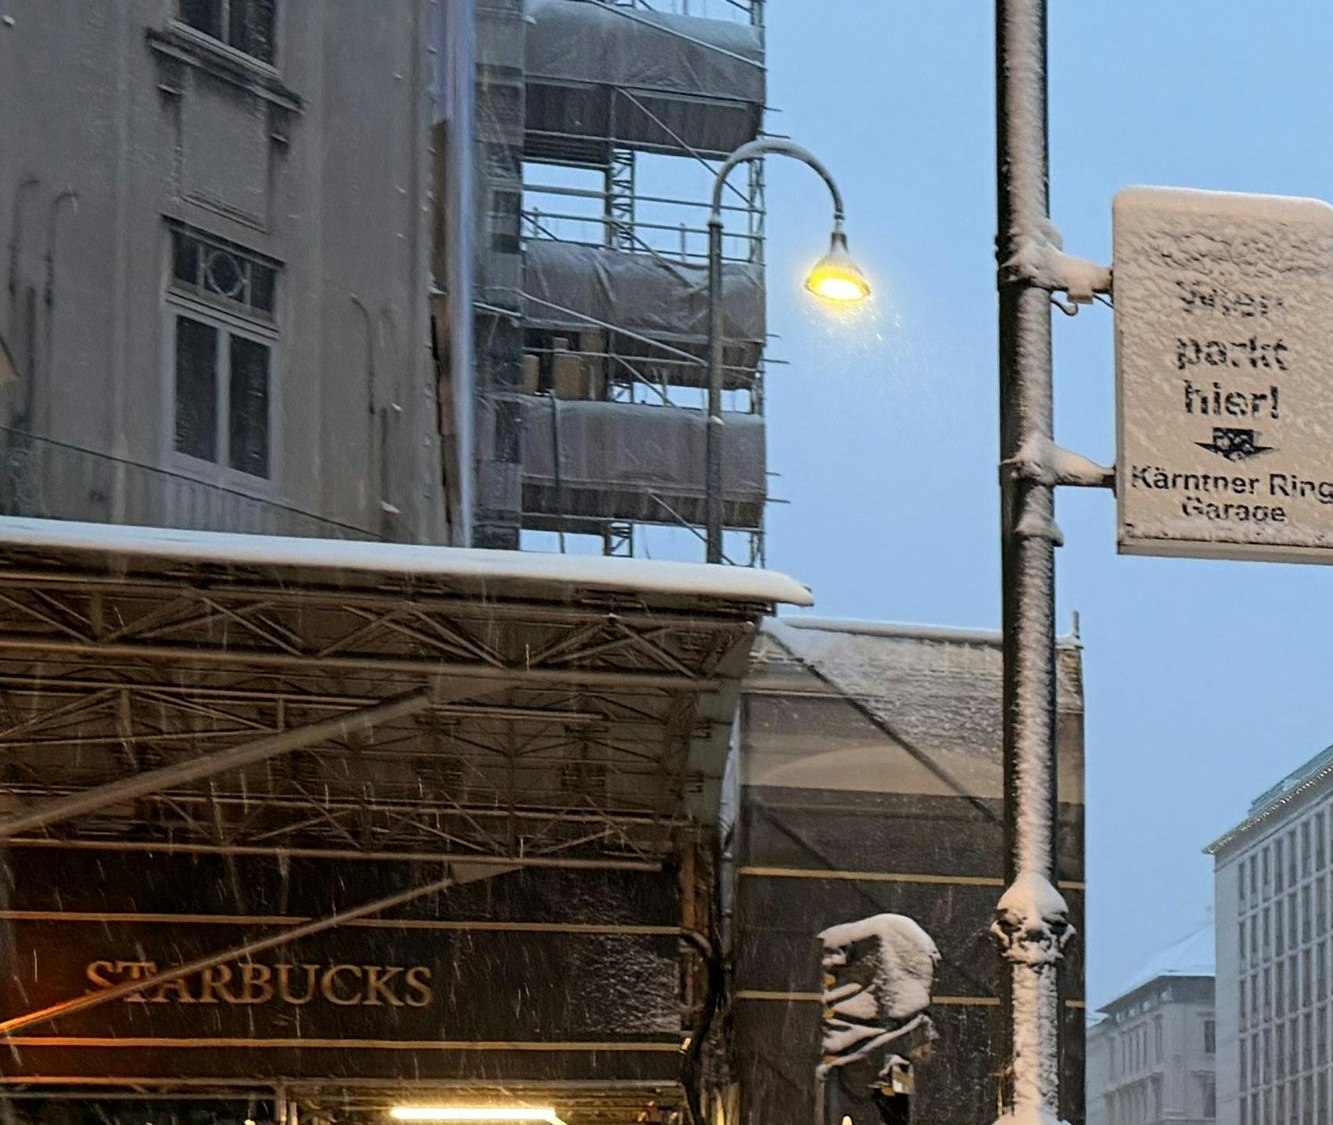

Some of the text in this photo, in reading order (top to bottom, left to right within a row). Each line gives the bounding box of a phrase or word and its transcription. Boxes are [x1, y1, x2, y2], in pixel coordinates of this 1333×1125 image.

[1176, 335, 1288, 371] parkt
[1183, 379, 1280, 419] hier!
[1131, 465, 1260, 496] Kärntner
[1182, 496, 1288, 523] Garage
[86, 959, 434, 1006] STARBUCKS
